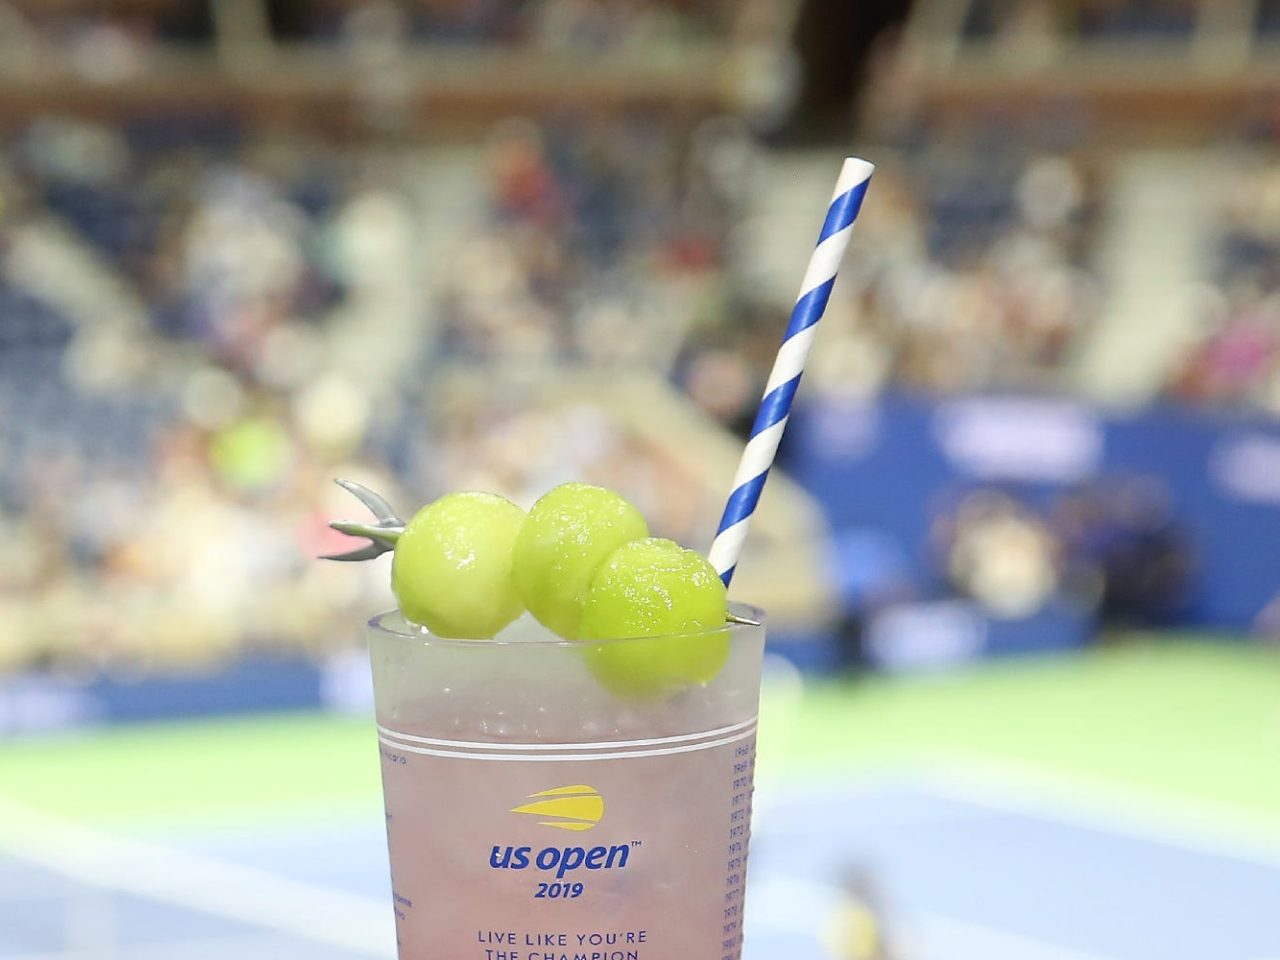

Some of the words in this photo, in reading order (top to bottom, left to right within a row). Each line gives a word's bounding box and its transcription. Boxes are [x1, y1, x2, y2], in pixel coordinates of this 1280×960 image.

[489, 846, 531, 869] us
[536, 844, 629, 878] open
[535, 882, 583, 898] 2019
[478, 930, 516, 944] LIVE
[526, 934, 567, 946] LIKE
[577, 931, 647, 945] YOU'RE
